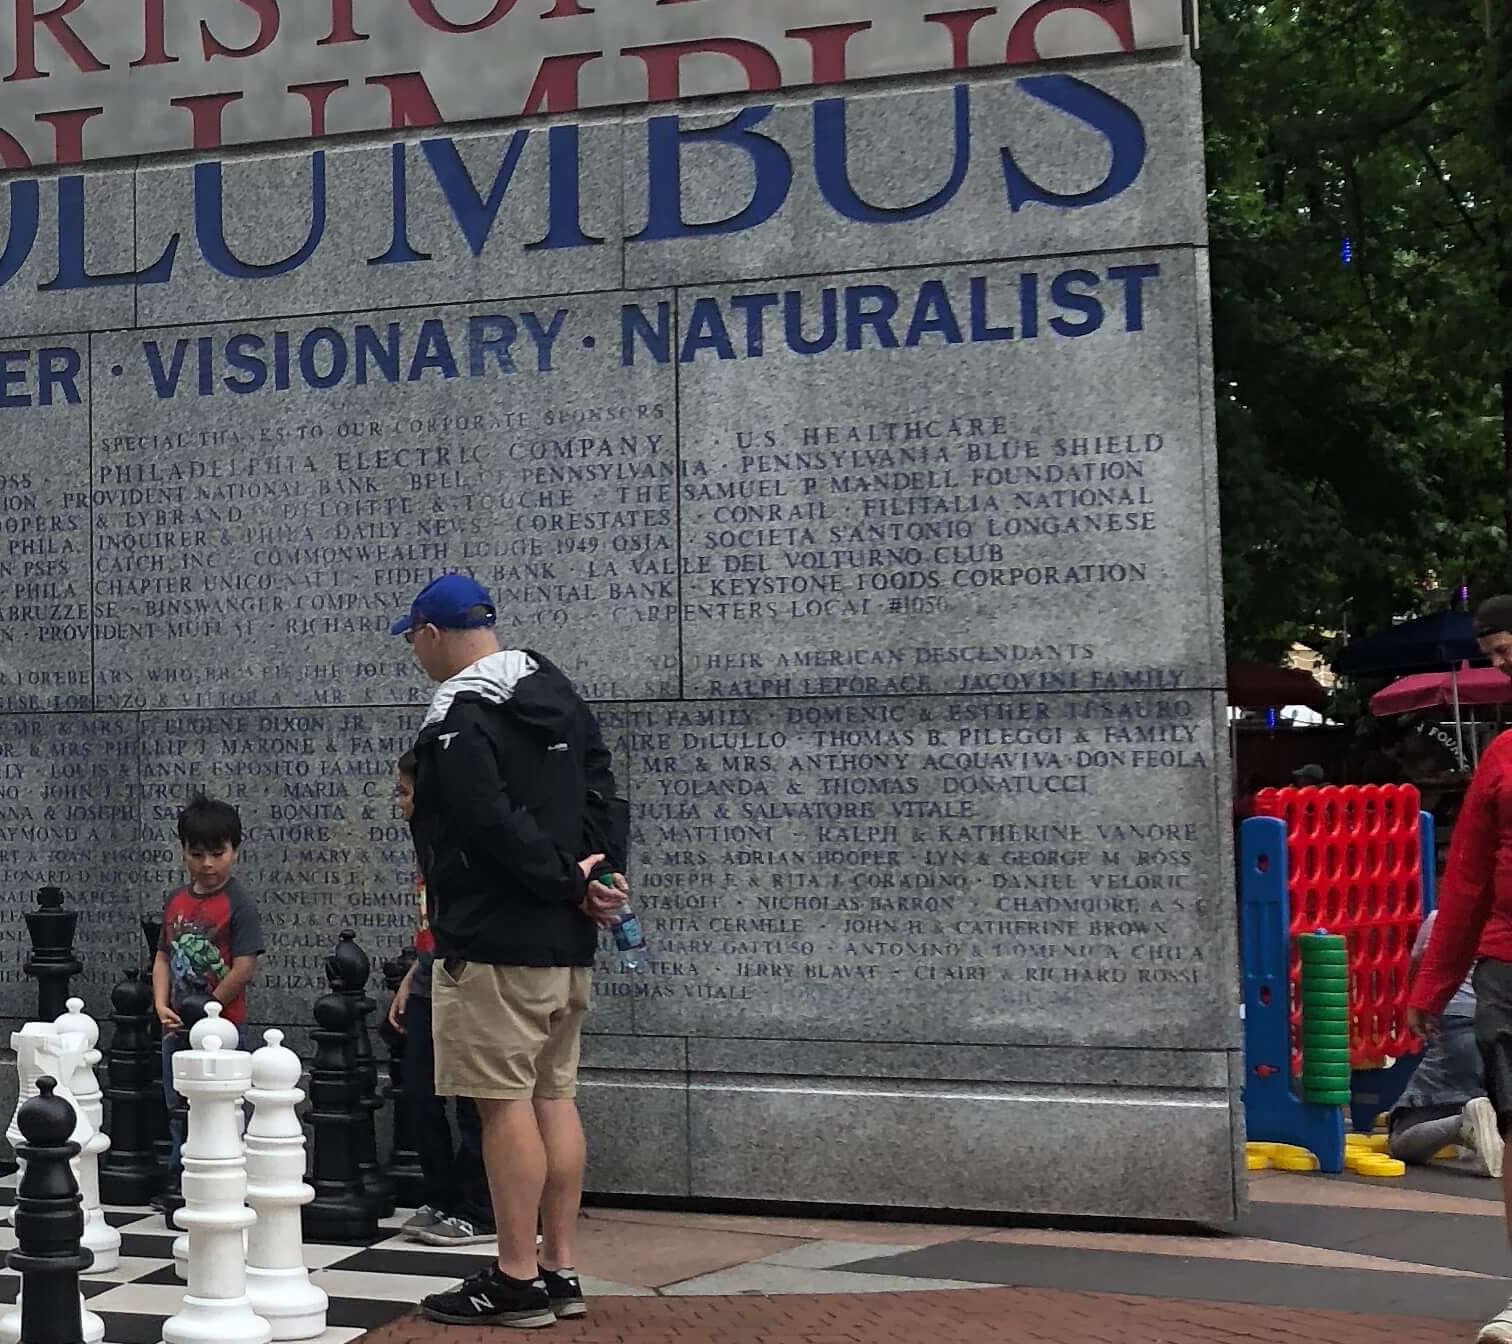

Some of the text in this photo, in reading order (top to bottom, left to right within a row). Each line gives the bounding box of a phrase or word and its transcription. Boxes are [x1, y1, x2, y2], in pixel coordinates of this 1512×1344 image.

[147, 311, 568, 403] VISIONARY
[621, 265, 1160, 367] NATURALIST
[99, 453, 317, 484] PHILADELPHIA
[336, 443, 490, 470] ELECTRIC
[508, 433, 664, 461] COMPANY
[802, 415, 1007, 445] HEALTHCARE
[101, 420, 382, 453] SPECIAL TO OUR
[62, 485, 186, 509] PROVIDENT
[194, 479, 300, 502] NATIONAL
[318, 474, 378, 495] BANK
[409, 469, 468, 491] BELL
[520, 456, 708, 485] PENNSYLVANIA
[740, 443, 955, 474] PENNSYLVANIA
[967, 439, 1040, 462] BLUE
[1054, 432, 1164, 457] SHIELD
[125, 504, 242, 528] LYBRAND
[460, 487, 574, 511] TOUCHE
[615, 482, 671, 504] THE
[682, 477, 787, 501] SAMUEL
[829, 468, 959, 494] MANDELL
[972, 459, 1144, 487] FOUNDATION
[98, 529, 207, 552] INQUIRER
[335, 520, 401, 541] DAILY
[514, 507, 672, 533] CORESTATES
[713, 501, 830, 524] CONRAIL
[862, 492, 999, 517] FILITALIA
[1014, 484, 1154, 510] NATIONAL
[23, 558, 70, 577] PSFS
[253, 541, 449, 568] COMMONWEALTH
[555, 534, 599, 554] 1949
[611, 531, 671, 552] OSIA
[704, 526, 816, 550] SOCIETA
[986, 511, 1157, 537] LONGANESE
[94, 574, 192, 596] CHAPTER
[203, 571, 272, 591] UNICO
[491, 561, 557, 581] BANK
[586, 558, 618, 578] LA
[630, 554, 711, 576] VALLE
[724, 553, 771, 573] DEL
[784, 546, 922, 571] VOLTURNO
[933, 543, 1004, 564] CLUB
[144, 594, 283, 617] BINSWANGER
[296, 589, 405, 611] COMPANY
[609, 579, 673, 600] BANK
[708, 573, 843, 597] KEYSTONE
[857, 569, 939, 591] FOODS
[952, 561, 1147, 588] CORPORATION
[38, 621, 153, 642] PROVIDENT
[285, 611, 391, 633] RICHARD
[612, 601, 777, 624] CARPENTERS
[790, 597, 872, 619] LOCAL
[776, 648, 907, 667] AMERICAN
[914, 642, 1095, 663] DESCENDANTS
[708, 678, 792, 697] RALPH
[959, 670, 1078, 691] JACOVINI
[1090, 667, 1186, 687] FAMILY
[258, 715, 325, 733] DIXON
[667, 708, 754, 727] FAMILY
[785, 705, 906, 725] DOMENIC
[948, 701, 1050, 721] ESTHER
[221, 737, 314, 755] MARONE
[814, 728, 914, 749] THOMAS
[958, 725, 1063, 746] PILEGGI
[1104, 722, 1200, 743] FAMILY
[143, 761, 201, 778] ANNE
[211, 759, 310, 777] ESPOSITO
[319, 758, 398, 775] FAMILY
[787, 752, 910, 772] ANTHONY
[920, 750, 1063, 772] ACQUAVIVA
[1076, 749, 1125, 769] DON
[1131, 748, 1208, 768] FEOLA
[282, 781, 348, 798] MARIA
[657, 777, 769, 796] YOLANDA
[819, 775, 920, 794] THOMAS
[943, 772, 1088, 792] DONATUCCI
[270, 803, 345, 821] BONITA
[742, 801, 876, 819] SALVATORE
[891, 799, 978, 818] VITALE
[657, 825, 774, 844] MATTIONI
[817, 824, 898, 843] RALPH
[937, 822, 1084, 842] KATHERINE
[1096, 820, 1199, 840] VANORE
[721, 848, 1193, 867] ADRIAN HOOPER GEORGE ROSS
[756, 895, 955, 912] NICHOLAS BARRON
[655, 918, 699, 934] RITA
[843, 918, 897, 934] JOHN
[954, 920, 1077, 936] CATHERINE
[1025, 965, 1202, 983] RICHARD ROSSI
[469, 1293, 495, 1312] N
